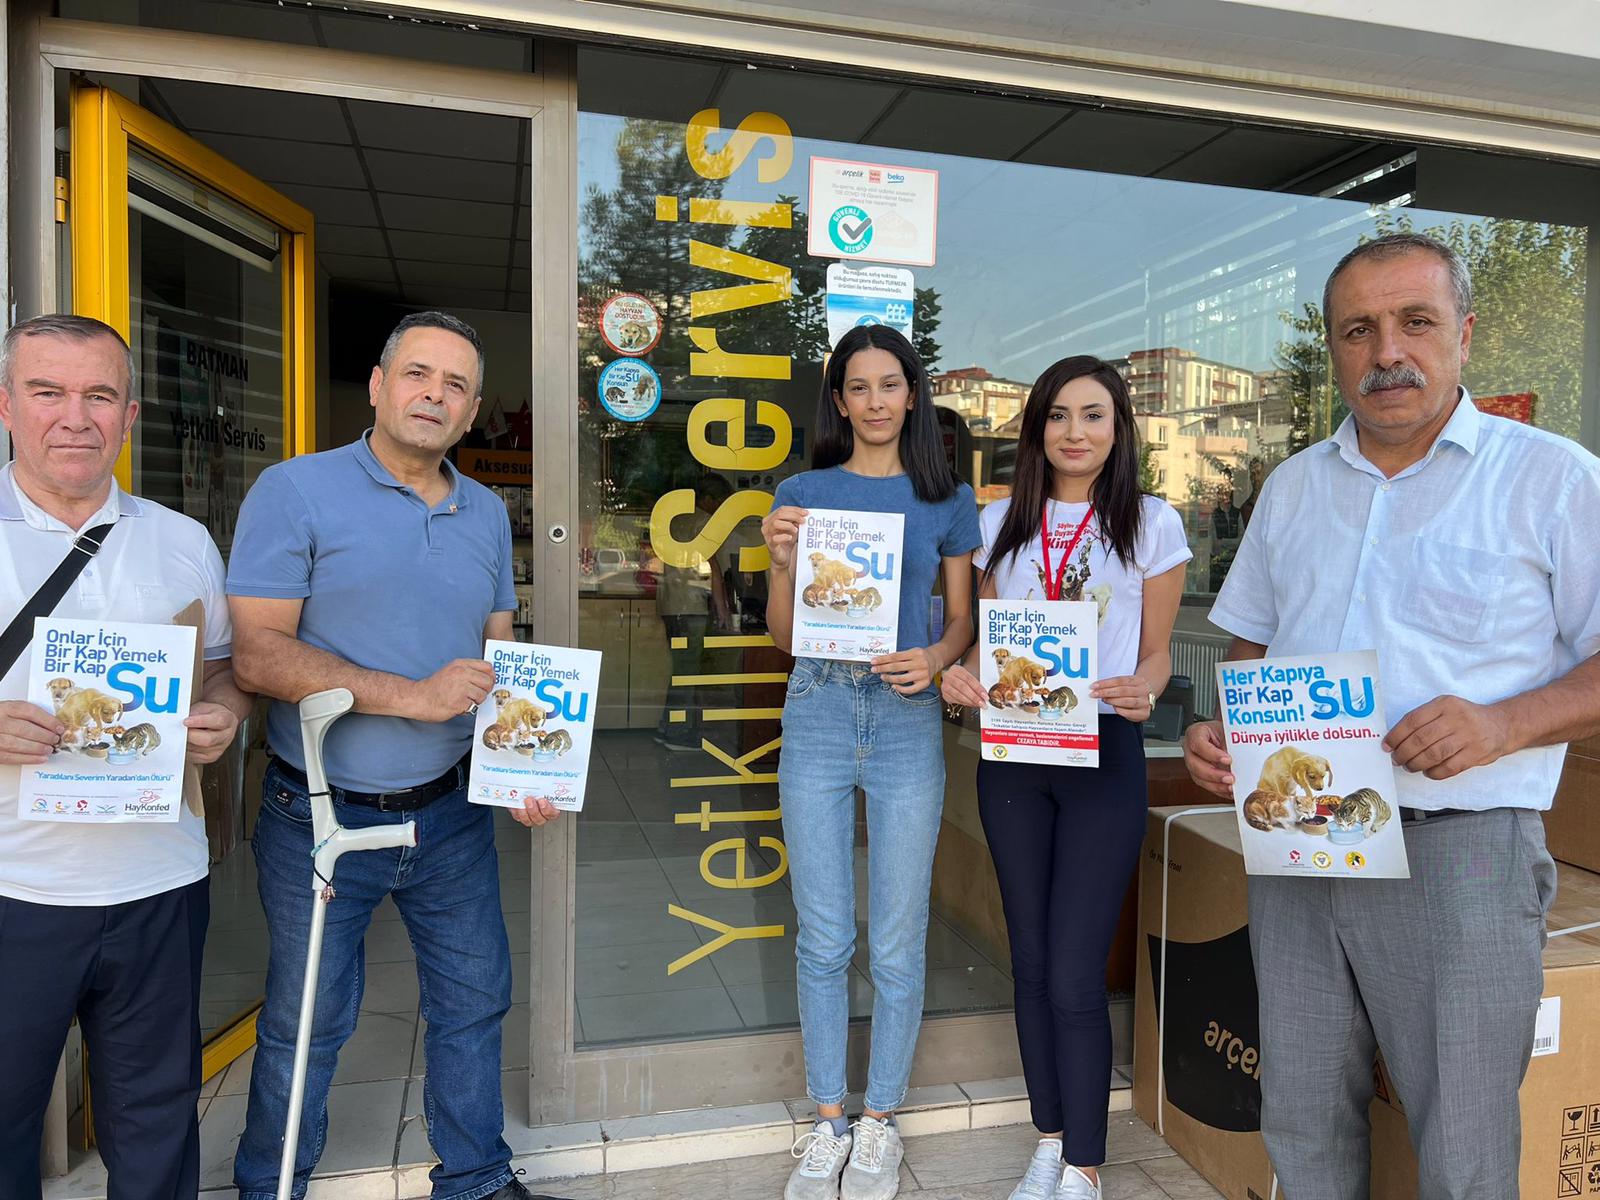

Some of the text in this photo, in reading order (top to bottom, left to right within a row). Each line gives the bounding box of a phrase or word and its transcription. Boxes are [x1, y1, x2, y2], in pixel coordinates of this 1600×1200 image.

[888, 172, 905, 180] beko
[649, 108, 794, 572] Servis
[187, 341, 248, 382] BATMAN
[626, 373, 640, 382] SU
[170, 411, 266, 452] Yetkili Servis
[808, 516, 858, 530] Onlar İçin
[807, 528, 885, 542] Bir Kap Yemek
[806, 538, 894, 580] Bir Kap Su
[988, 608, 1046, 623] Onlar İçin
[46, 628, 127, 648] Onlar İçin
[988, 622, 1077, 636] Bir Kap Yemek
[44, 644, 168, 663] Bir Kap Yemek
[494, 650, 552, 666] Onlar İçin
[860, 646, 890, 654] HayKonfed
[988, 634, 1088, 678] Bir Kap Su
[493, 662, 580, 681] Bir Kap Yemek
[1222, 665, 1326, 688] Her Kapıya
[44, 659, 180, 714] Bir Kap Su
[494, 674, 589, 722] Bir Kap Su
[1226, 687, 1293, 708] Bir Kap
[1228, 676, 1376, 726] Konsun! SU
[1231, 727, 1380, 746] Dünya iyilikle dolsun..
[74, 772, 106, 782] Severim
[106, 773, 150, 782] Yaradan'dan
[124, 803, 170, 814] HayKonfed
[544, 795, 576, 804] HayKonfed
[667, 634, 789, 976] Yetkili
